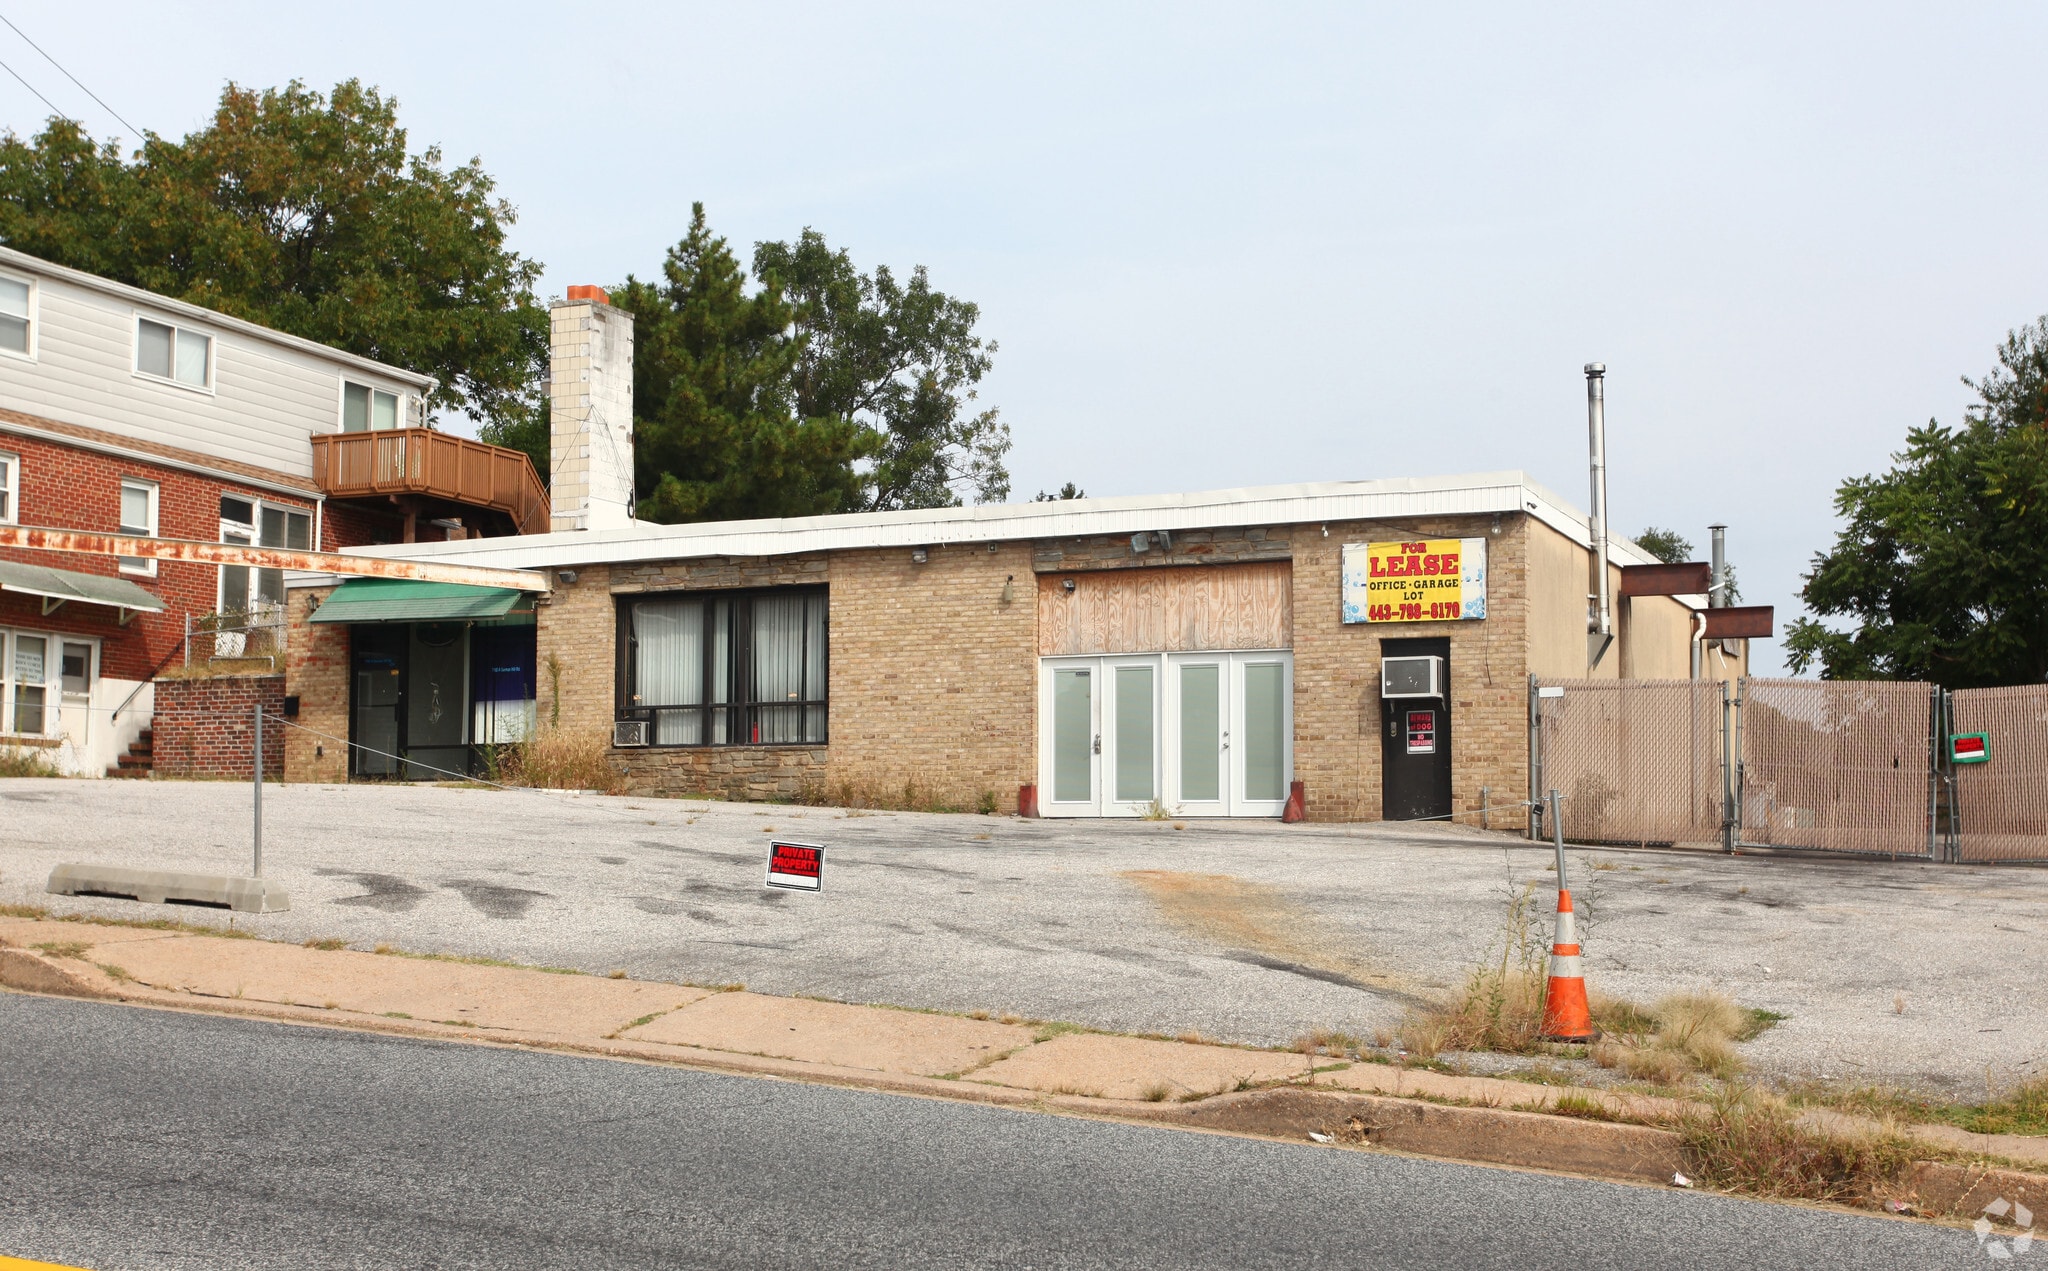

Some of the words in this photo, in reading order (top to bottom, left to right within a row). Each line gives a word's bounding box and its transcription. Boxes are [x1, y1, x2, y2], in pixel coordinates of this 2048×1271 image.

[1401, 543, 1427, 554] FOR
[1369, 554, 1459, 577] LEASE
[1370, 581, 1406, 590] OFFICE
[1414, 579, 1458, 588] GARAGE
[1404, 592, 1423, 600] LOT
[778, 846, 816, 860] PRIVATE
[772, 856, 819, 871] PROPERTY
